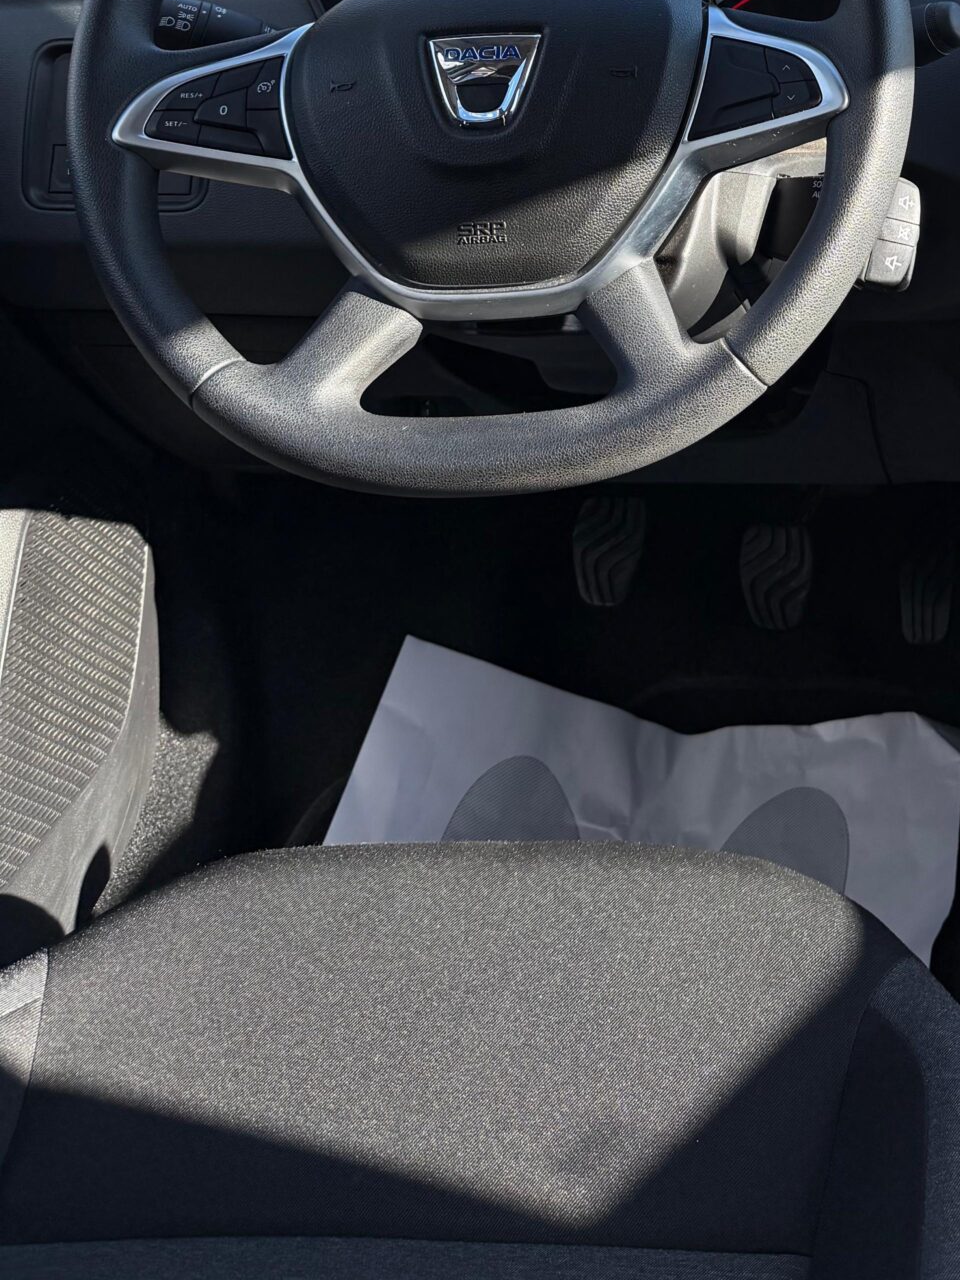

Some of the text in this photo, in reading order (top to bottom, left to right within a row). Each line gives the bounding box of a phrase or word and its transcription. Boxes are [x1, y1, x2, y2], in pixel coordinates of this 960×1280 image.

[177, 3, 198, 12] AUTO
[444, 44, 521, 61] DACIA
[458, 221, 507, 236] SRP
[457, 235, 508, 245] AIRBAG
